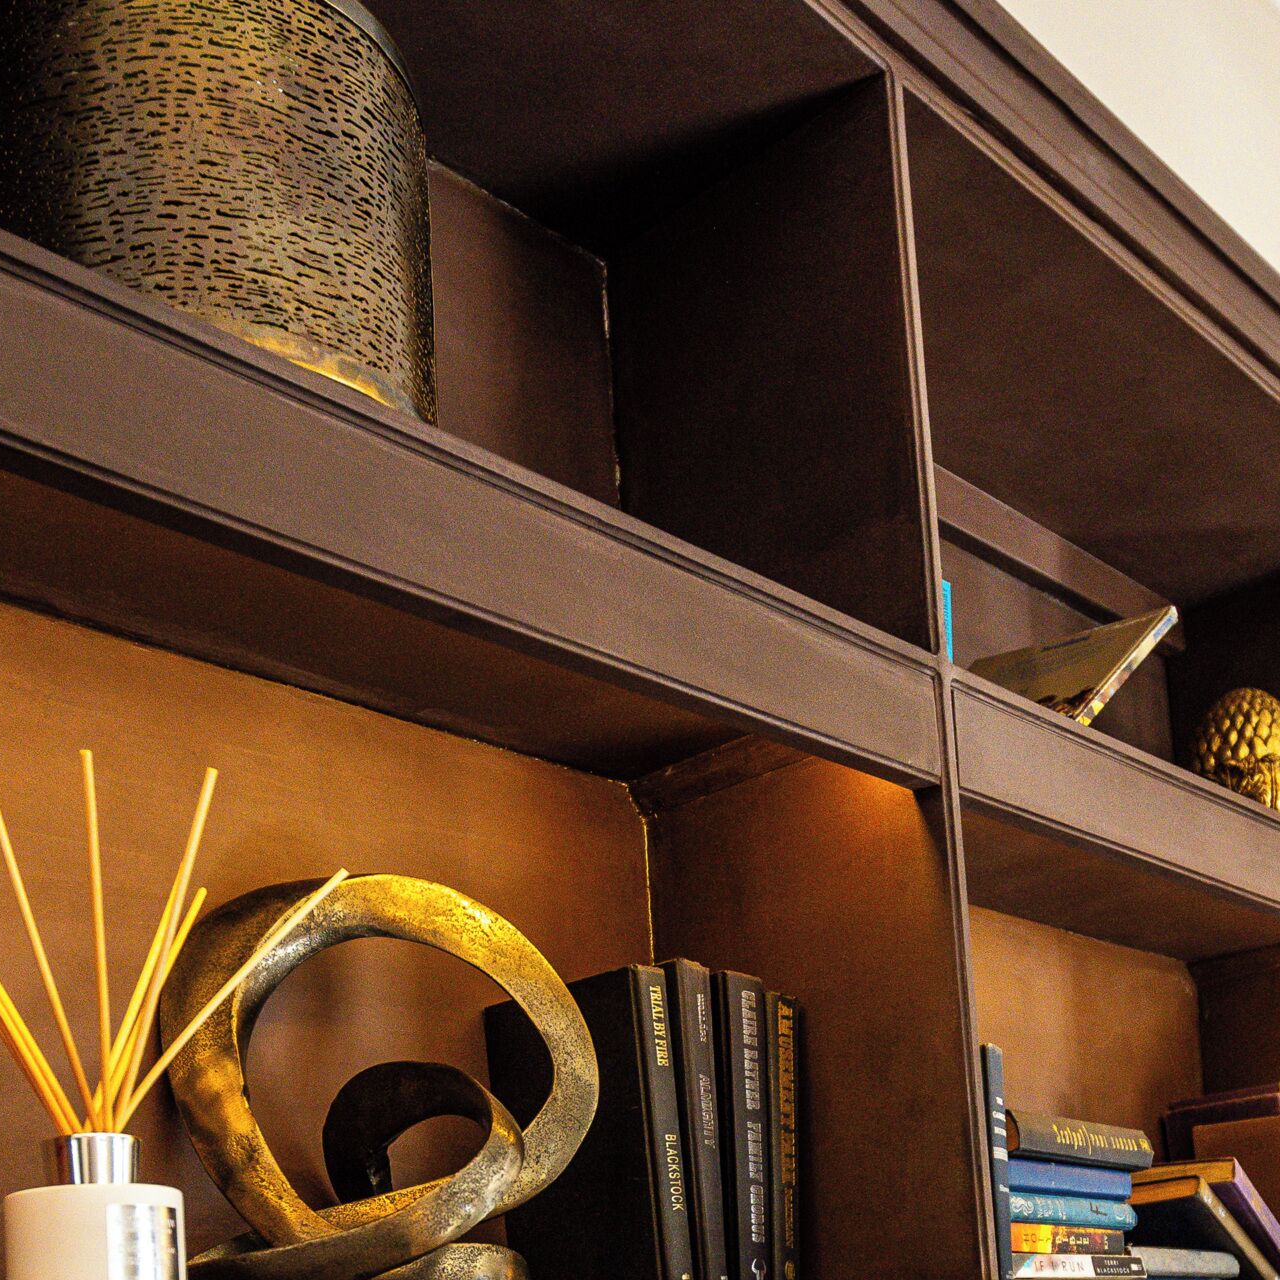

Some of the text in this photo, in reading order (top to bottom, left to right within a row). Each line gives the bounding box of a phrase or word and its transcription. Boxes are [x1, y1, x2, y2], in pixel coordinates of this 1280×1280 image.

[649, 984, 670, 1068] TRIAL BY FIRE
[741, 989, 761, 1112] CLAIRE RAYNER
[664, 1133, 685, 1213] BLACKSTOCK
[746, 1120, 766, 1245] FAMILY CHORUS
[1034, 1260, 1045, 1273] IF
[1061, 1260, 1085, 1273] RUN
[1055, 1235, 1090, 1245] BIBLE
[1096, 1267, 1131, 1275] BLACKSTOCK
